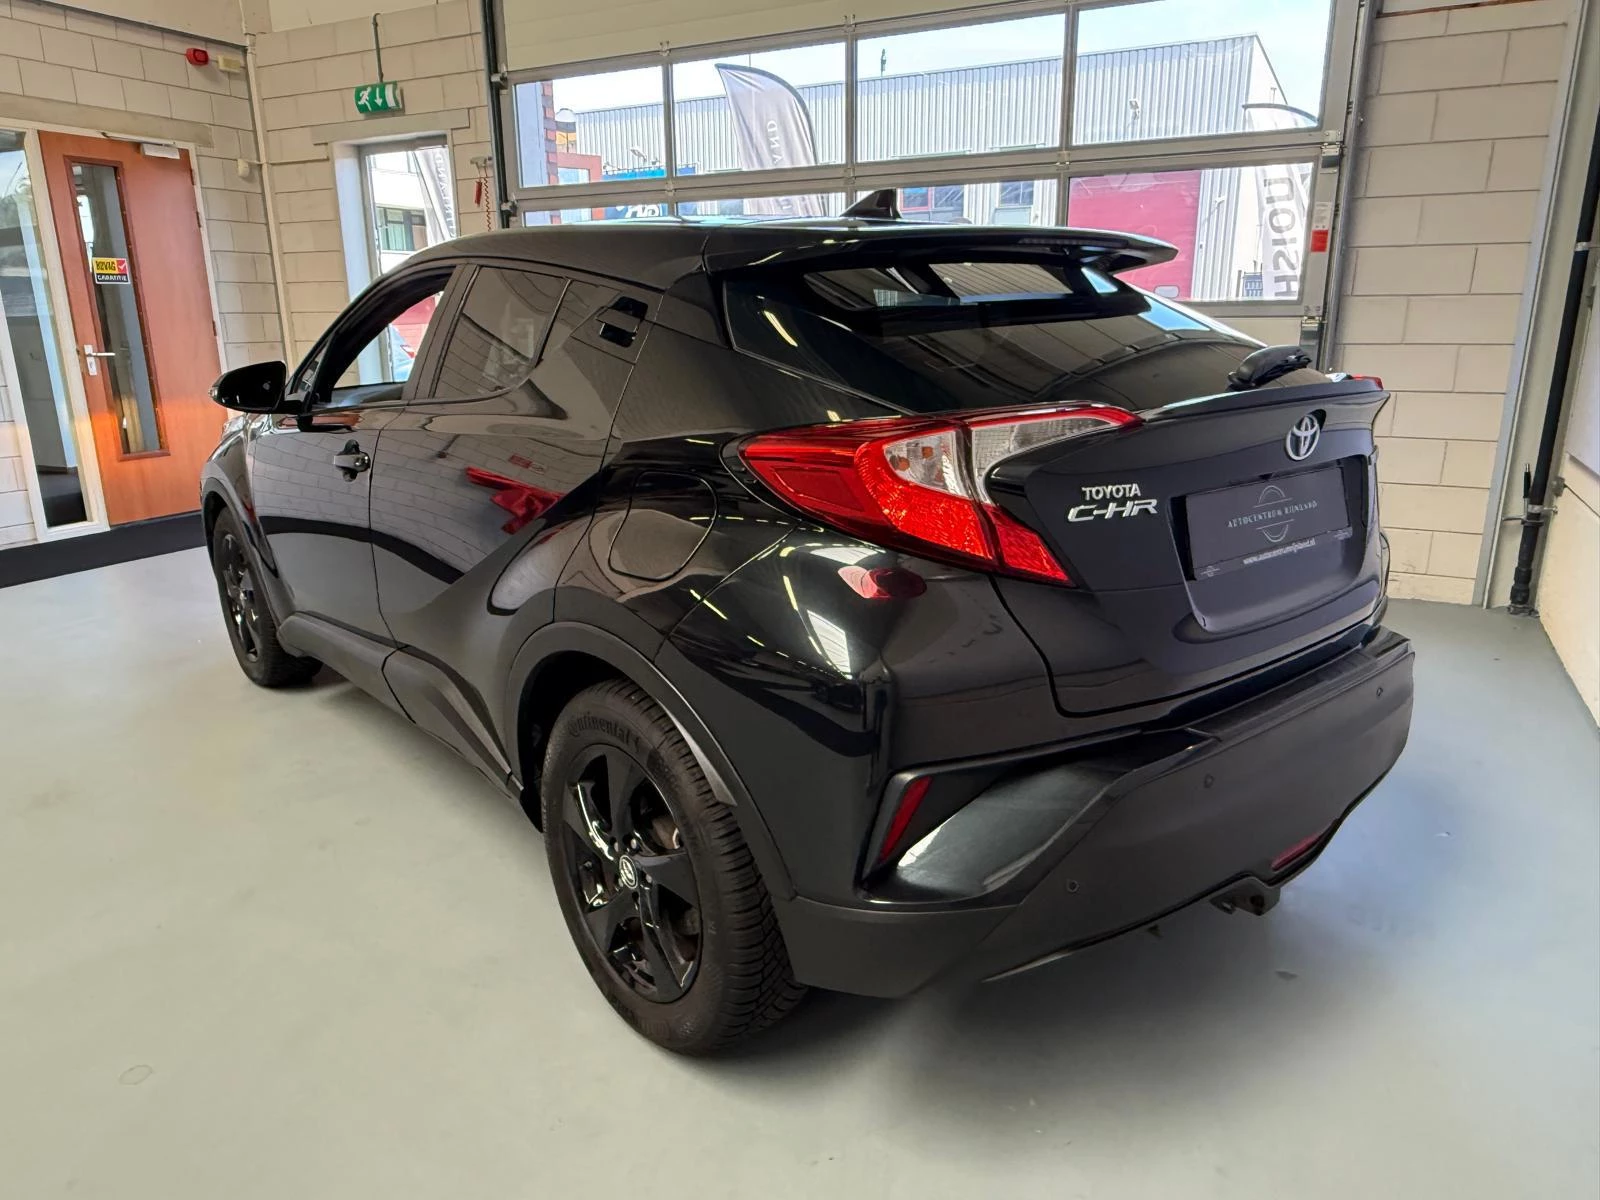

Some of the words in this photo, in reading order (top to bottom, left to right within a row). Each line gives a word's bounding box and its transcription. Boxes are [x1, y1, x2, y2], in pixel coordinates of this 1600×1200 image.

[1081, 483, 1141, 501] TOYOTA
[1067, 499, 1158, 522] C-HR
[567, 711, 631, 746] Continental
